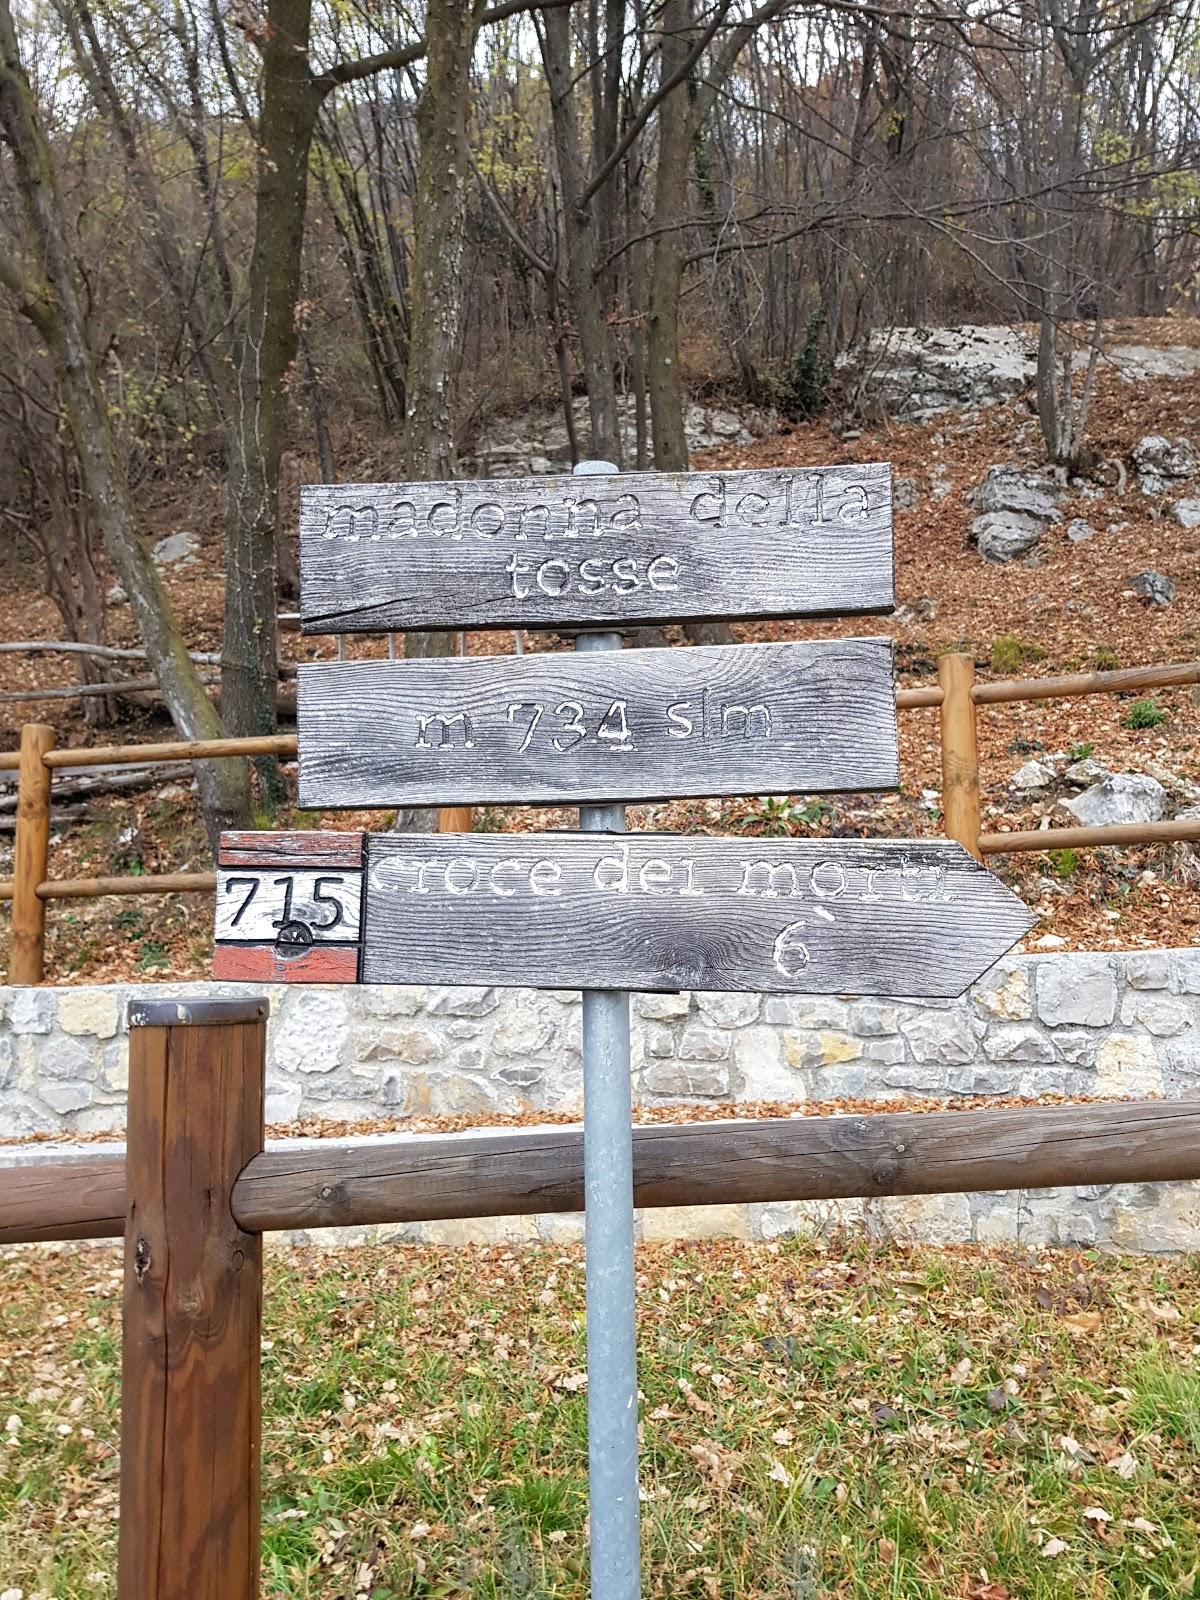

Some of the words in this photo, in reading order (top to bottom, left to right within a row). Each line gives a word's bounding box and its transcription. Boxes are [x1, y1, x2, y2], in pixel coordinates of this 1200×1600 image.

[322, 488, 643, 541] madonna
[690, 473, 869, 528] della
[506, 551, 680, 598] tosse
[415, 713, 476, 749] m
[507, 699, 637, 752] 734
[667, 689, 773, 738] slm
[593, 842, 703, 895] dei
[736, 850, 957, 902] morti
[226, 876, 345, 930] 715
